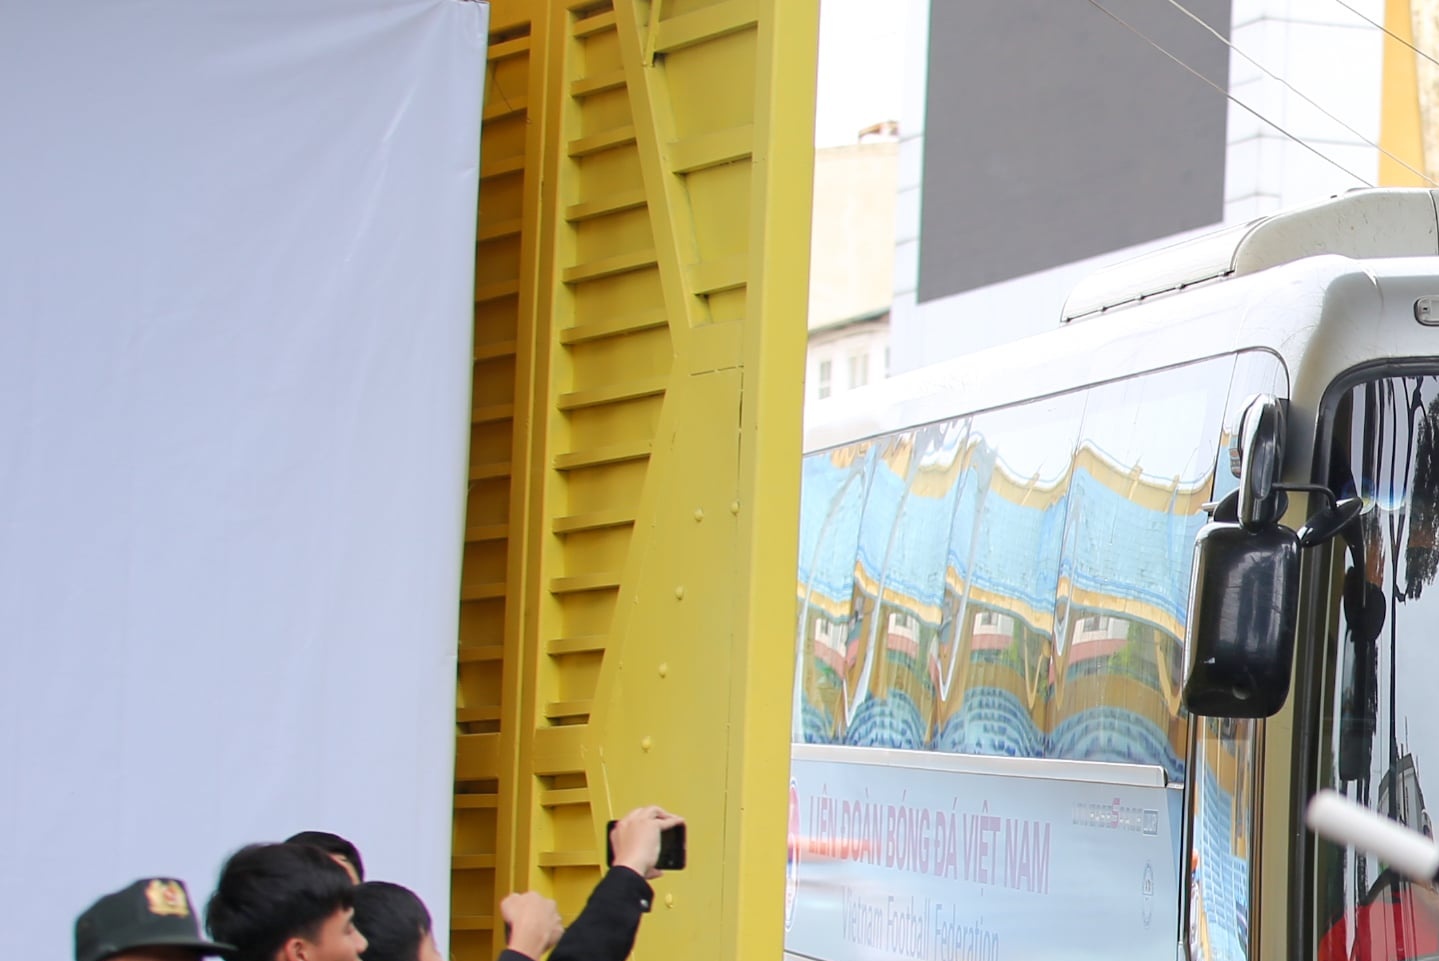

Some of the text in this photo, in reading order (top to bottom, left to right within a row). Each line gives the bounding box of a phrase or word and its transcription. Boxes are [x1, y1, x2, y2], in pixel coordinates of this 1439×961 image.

[810, 783, 838, 858] LIÊN
[840, 787, 883, 866] ĐOÀN
[886, 789, 931, 875] BÓNG
[934, 796, 958, 880] ĐÁ
[963, 799, 1001, 897] VIỆT
[1004, 817, 1051, 895] NAM
[842, 886, 883, 949] Vietnam
[887, 895, 932, 961] Football
